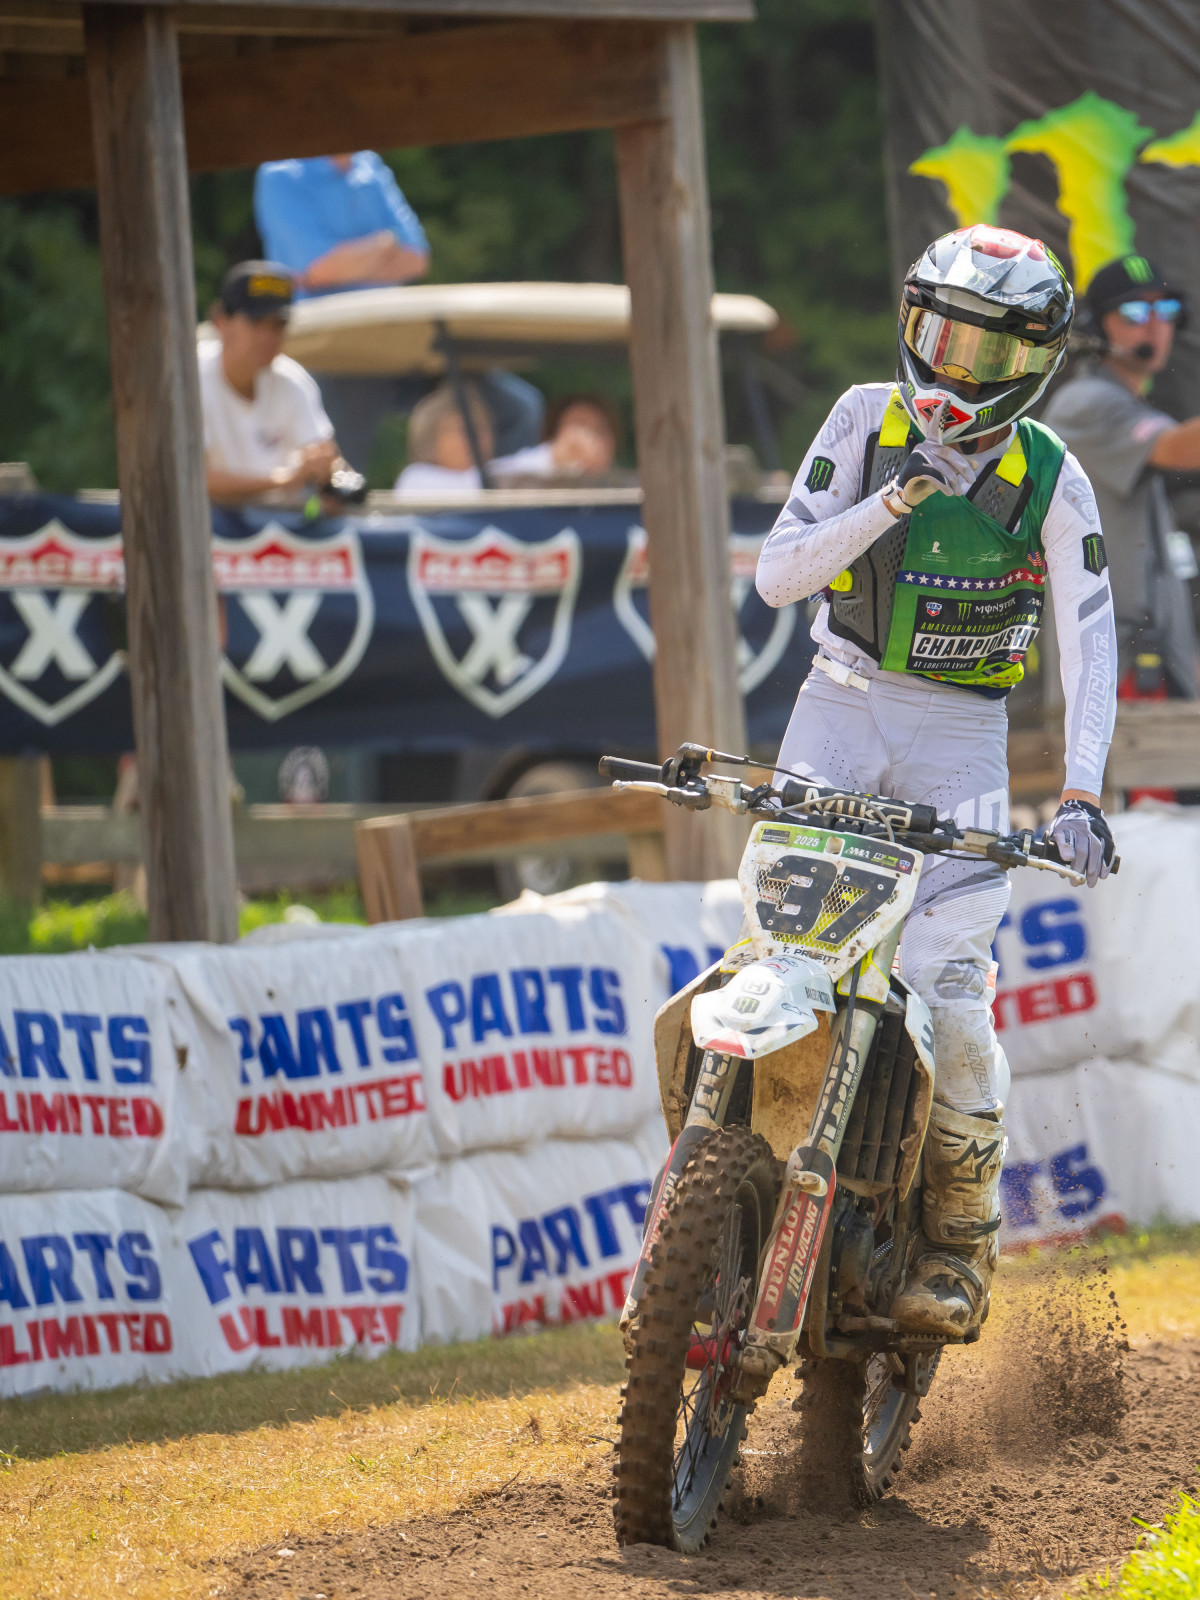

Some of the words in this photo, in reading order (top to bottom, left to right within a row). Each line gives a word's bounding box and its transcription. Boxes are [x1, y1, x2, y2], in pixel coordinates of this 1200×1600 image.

[10, 588, 97, 681] X
[241, 591, 328, 682] X
[456, 592, 536, 685] X
[920, 621, 963, 633] AMATEUR
[965, 622, 1003, 633] NATIONAL
[975, 597, 1016, 614] MONSTER
[793, 834, 820, 847] 2025
[755, 854, 899, 945] 37
[0, 1009, 153, 1085] RTS
[228, 992, 420, 1086] PARTS
[424, 964, 628, 1050] PARTS
[0, 1312, 173, 1369] LIMITED
